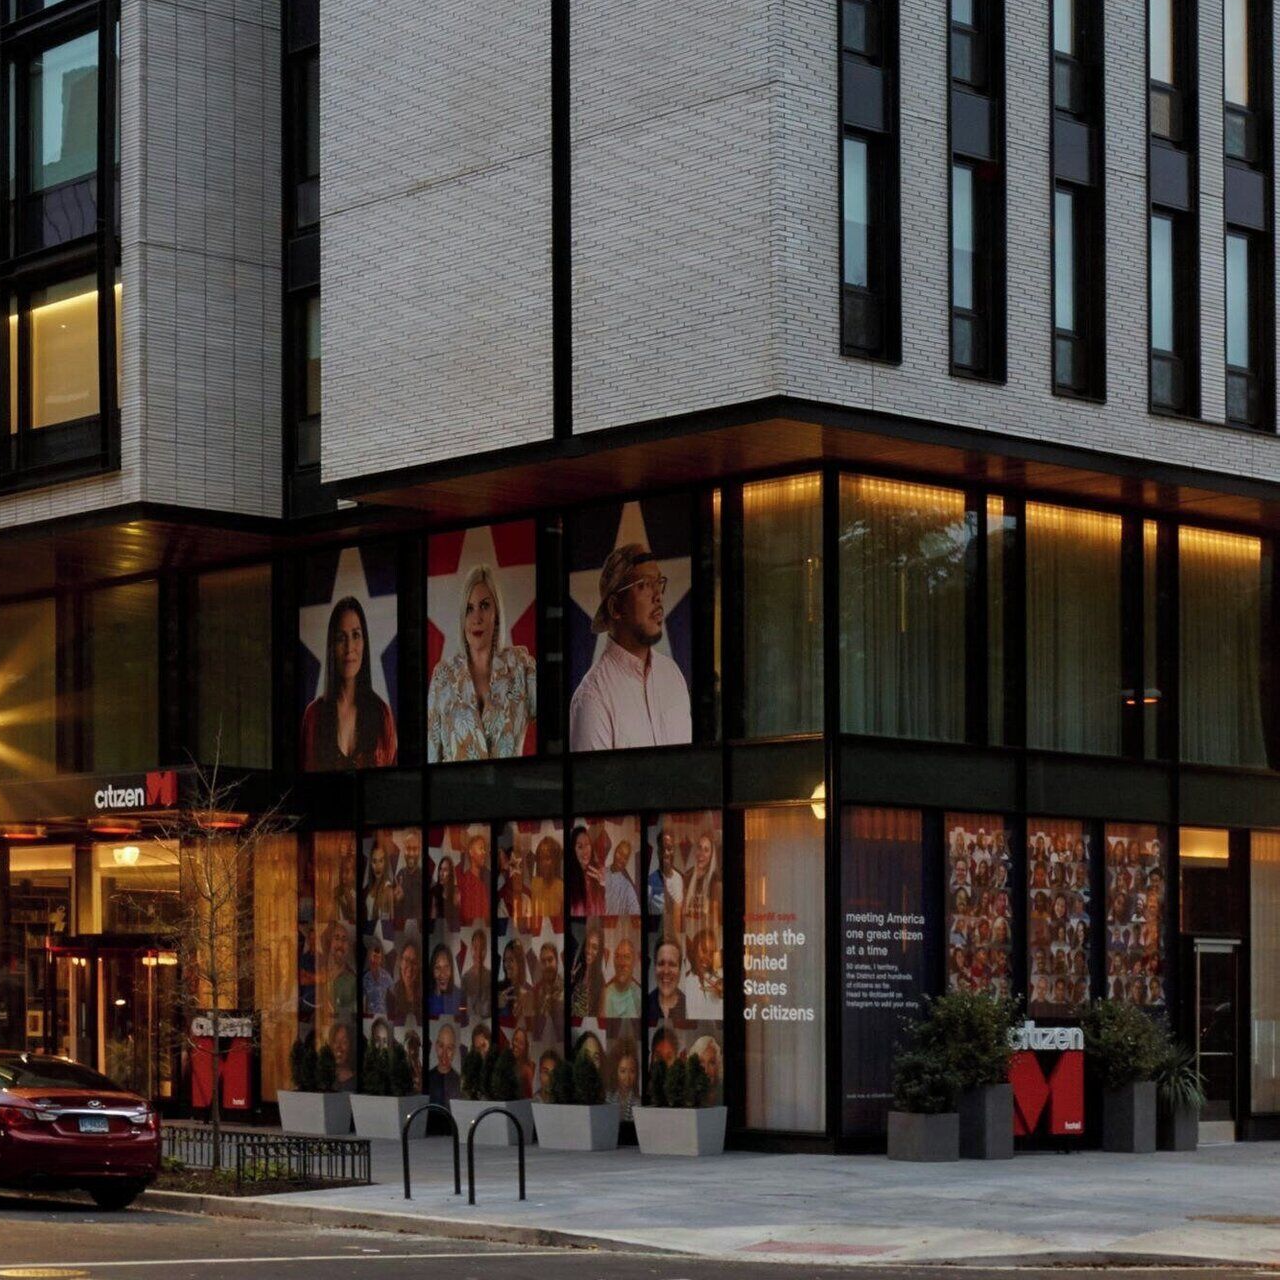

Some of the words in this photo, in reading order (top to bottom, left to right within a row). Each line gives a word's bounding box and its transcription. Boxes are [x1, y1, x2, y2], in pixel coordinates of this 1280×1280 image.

[845, 912, 885, 927] meeting
[886, 912, 925, 925] America
[743, 930, 779, 946] meet
[782, 928, 806, 946] the
[845, 929, 864, 939] one
[866, 929, 891, 943] great
[893, 928, 923, 941] citizen
[845, 945, 856, 956] at
[858, 946, 865, 956] a
[867, 944, 889, 957] time
[743, 953, 788, 971] United
[743, 979, 788, 996] States
[743, 1003, 757, 1020] of
[761, 1004, 815, 1021] citizens
[1006, 1020, 1084, 1050] citizen
[1064, 1120, 1082, 1130] hotel
